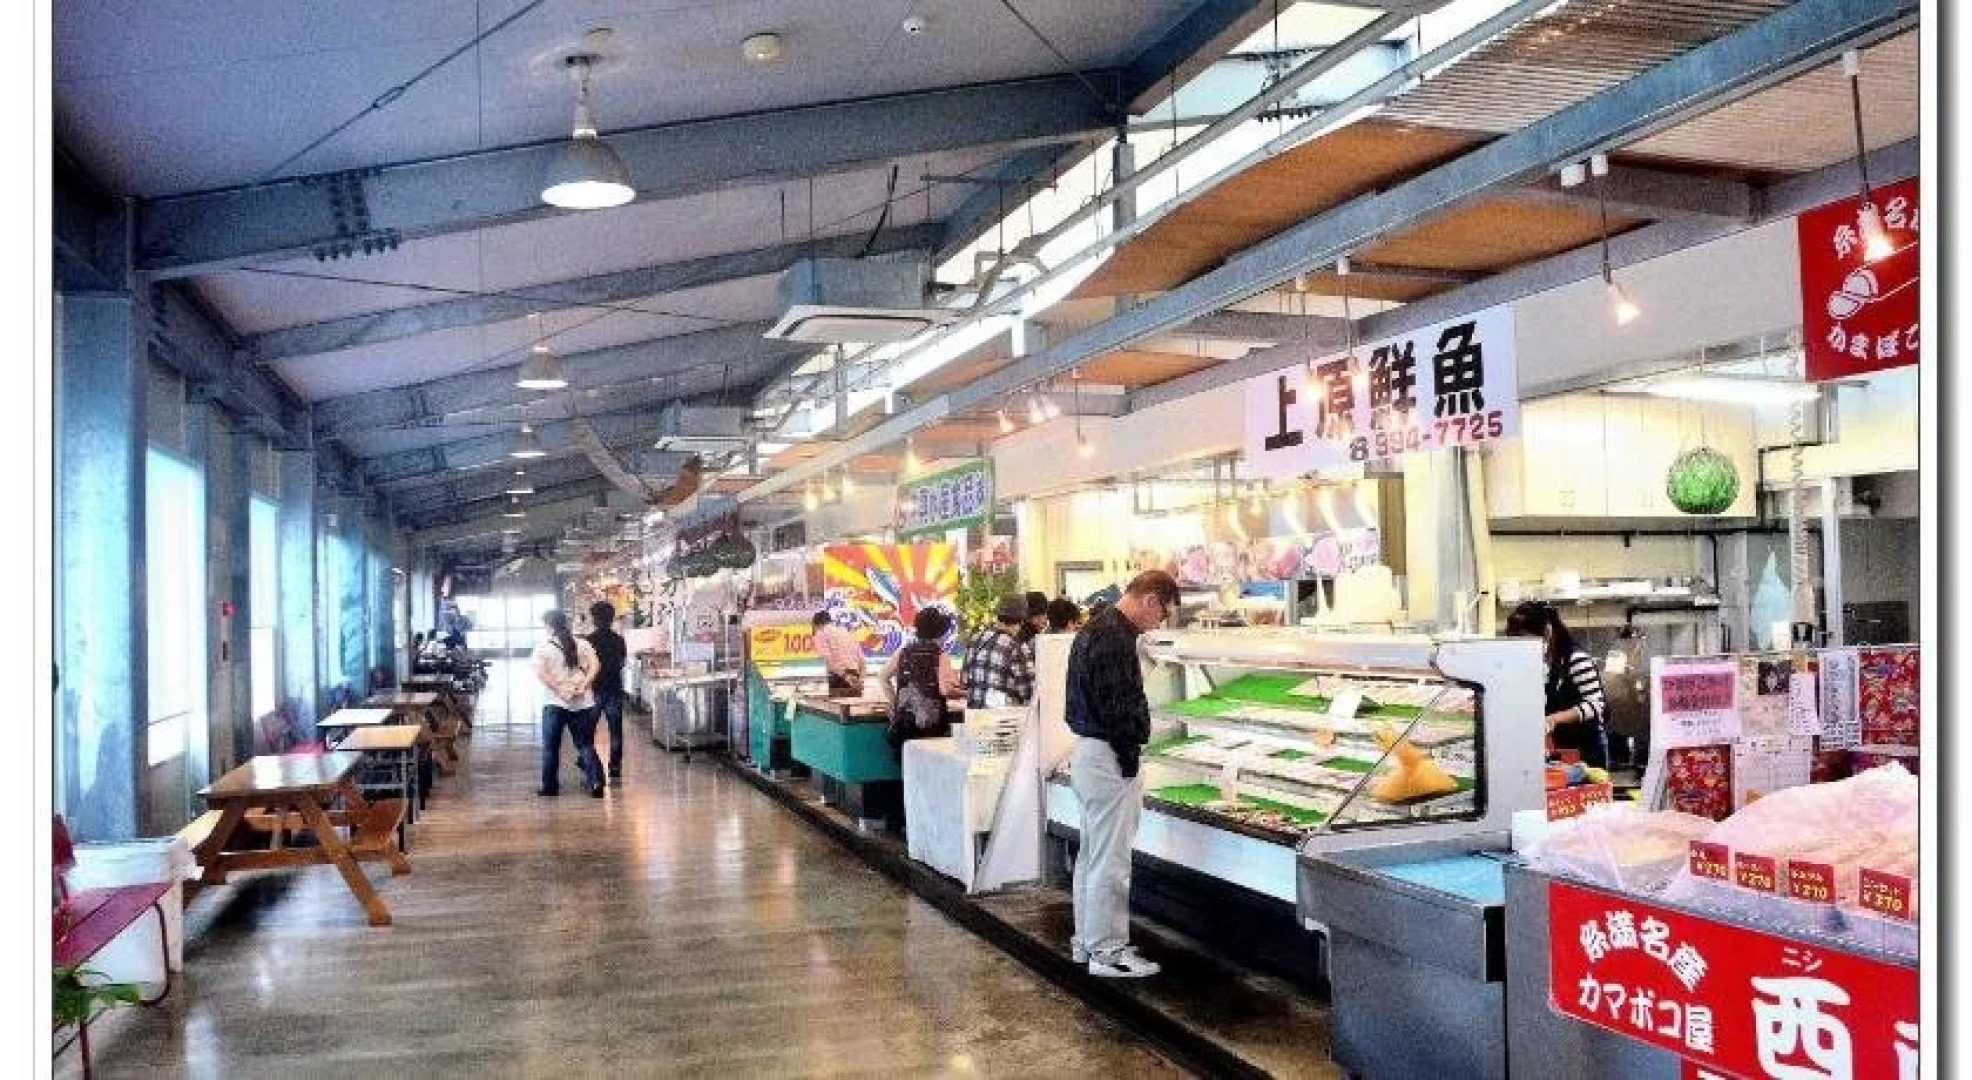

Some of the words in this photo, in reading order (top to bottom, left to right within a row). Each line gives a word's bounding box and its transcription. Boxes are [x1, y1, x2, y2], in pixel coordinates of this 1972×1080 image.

[1833, 196, 1918, 259] 糸名
[1264, 321, 1484, 450] 上原鮮魚
[1579, 910, 1709, 993] 糸満名産
[1781, 946, 1823, 973] ニシ
[1578, 971, 1714, 1054] カマボコ屋
